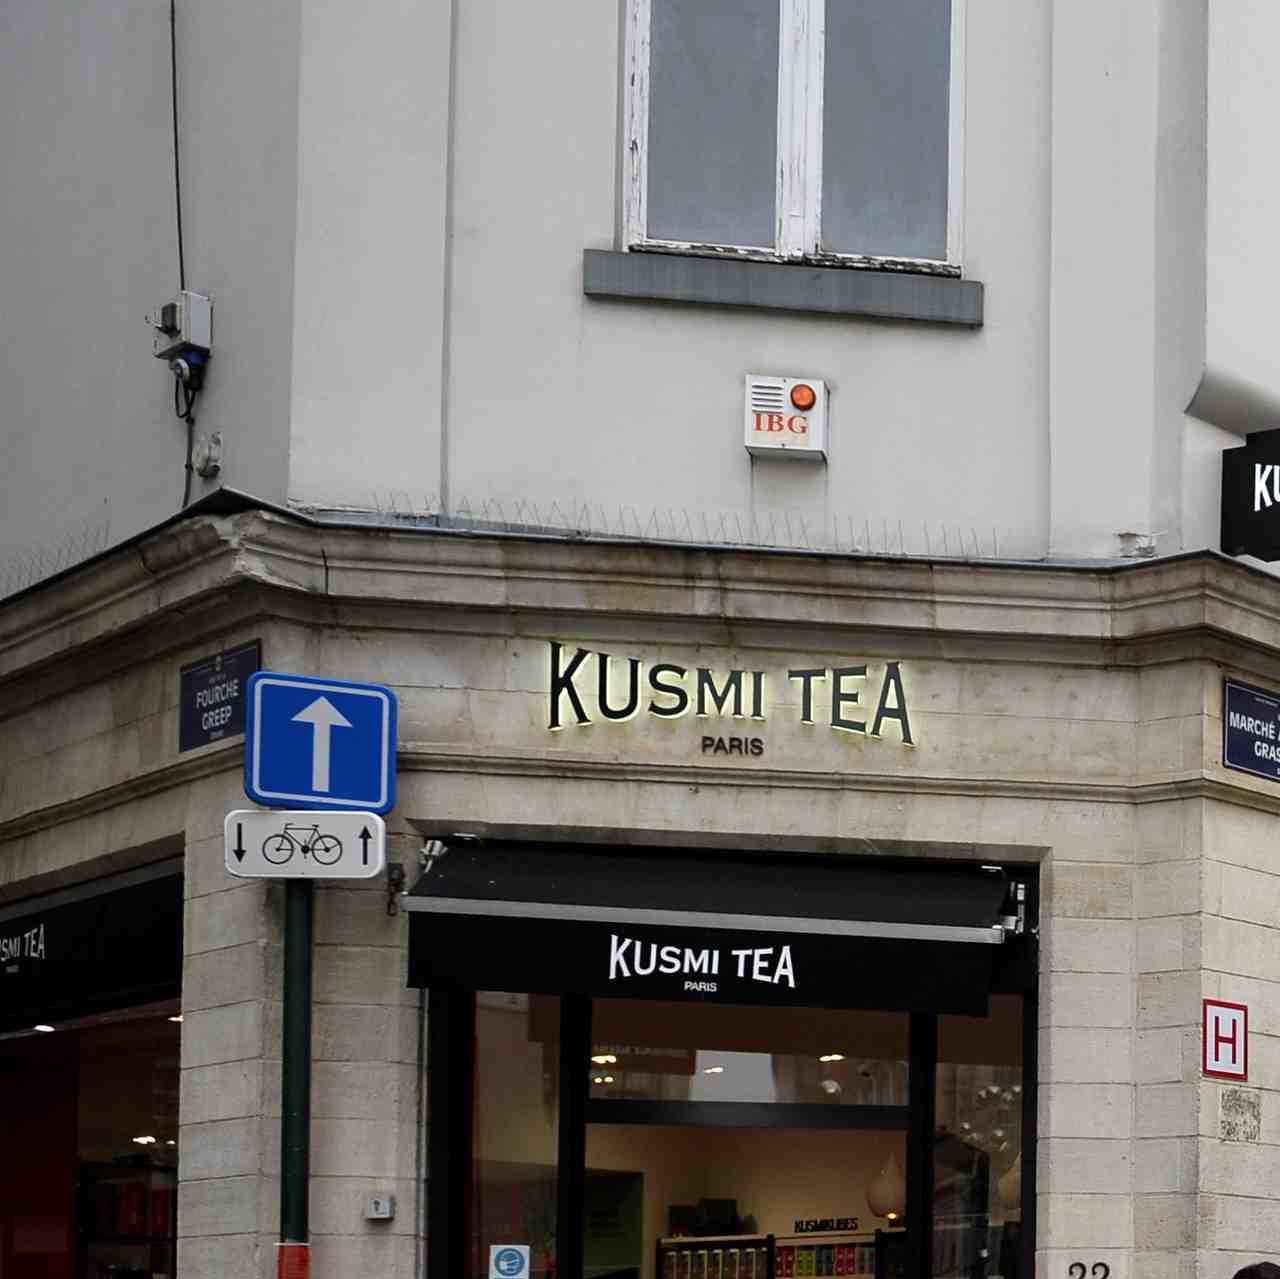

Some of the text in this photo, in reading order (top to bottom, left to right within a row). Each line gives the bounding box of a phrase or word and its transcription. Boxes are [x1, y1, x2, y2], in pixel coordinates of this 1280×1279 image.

[755, 413, 808, 433] IBG
[196, 679, 239, 709] FOURCHE
[549, 641, 915, 746] KUSMI TEA
[202, 705, 232, 731] GREEP
[1229, 711, 1276, 740] MARCHÉ
[701, 736, 764, 755] PARIS
[0, 923, 46, 962] SMI TEA
[609, 934, 796, 989] KUSMI TEA
[684, 980, 718, 993] PARIS
[1214, 1015, 1237, 1065] H
